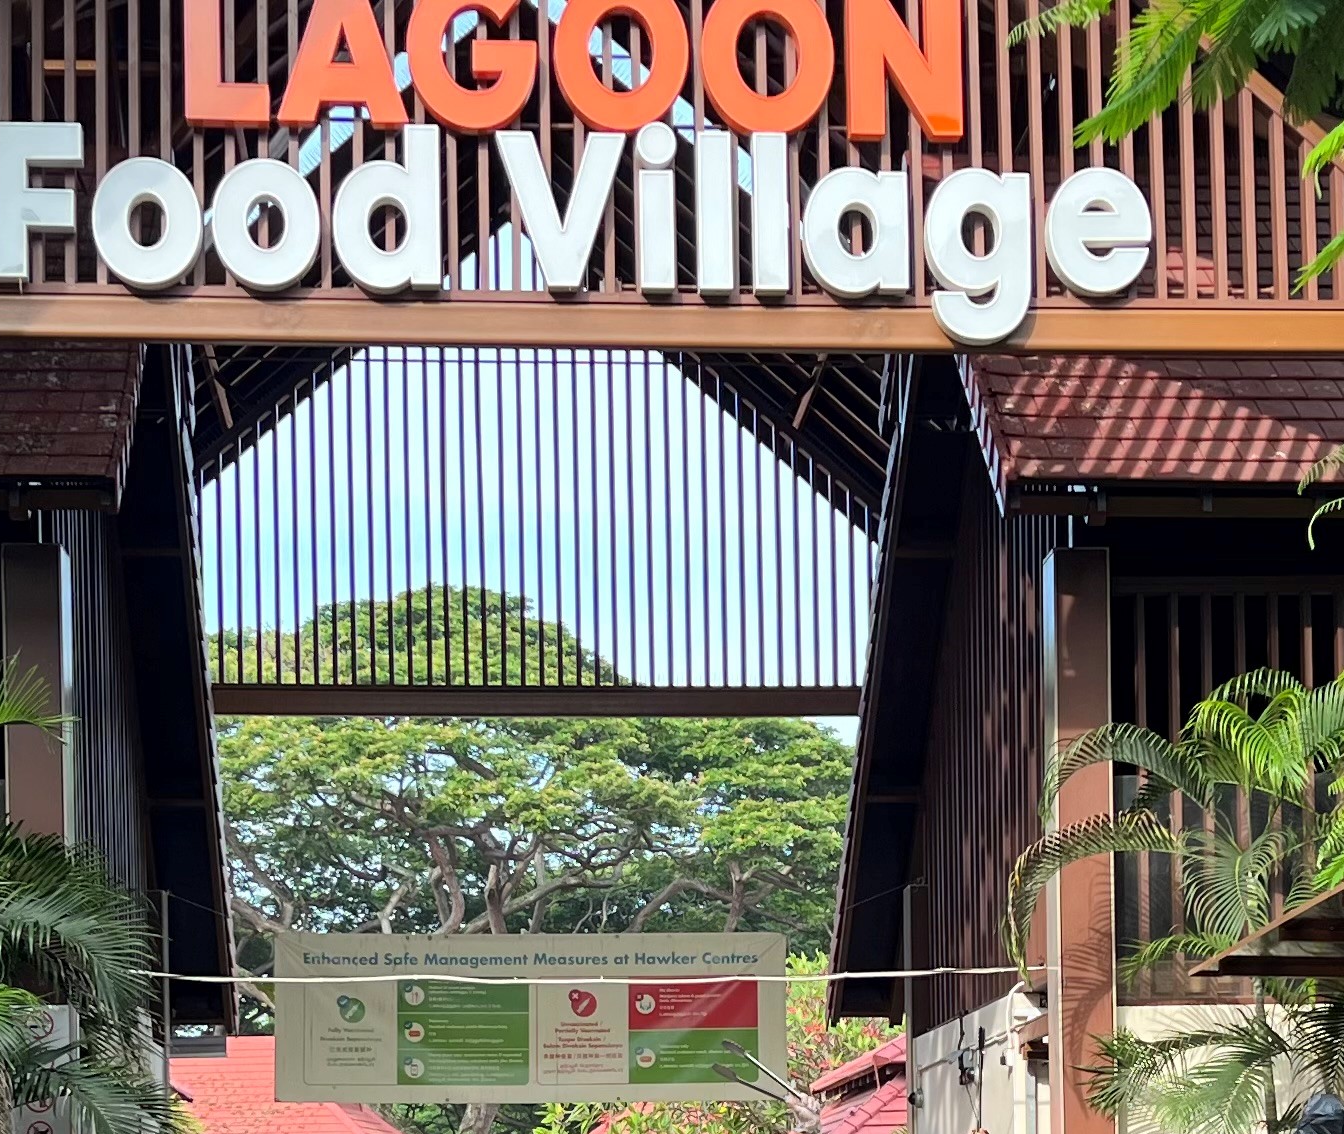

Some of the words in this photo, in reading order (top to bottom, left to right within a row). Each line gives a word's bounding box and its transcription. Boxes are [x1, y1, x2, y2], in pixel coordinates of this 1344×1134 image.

[183, 0, 963, 143] LAGOON
[495, 121, 1152, 345] Village
[303, 952, 378, 966] Enhanced
[383, 952, 418, 966] Safe
[424, 953, 528, 969] Management
[533, 952, 608, 966] Measures
[613, 953, 629, 966] at
[634, 952, 697, 965] Hawker
[702, 951, 759, 965] Centres
